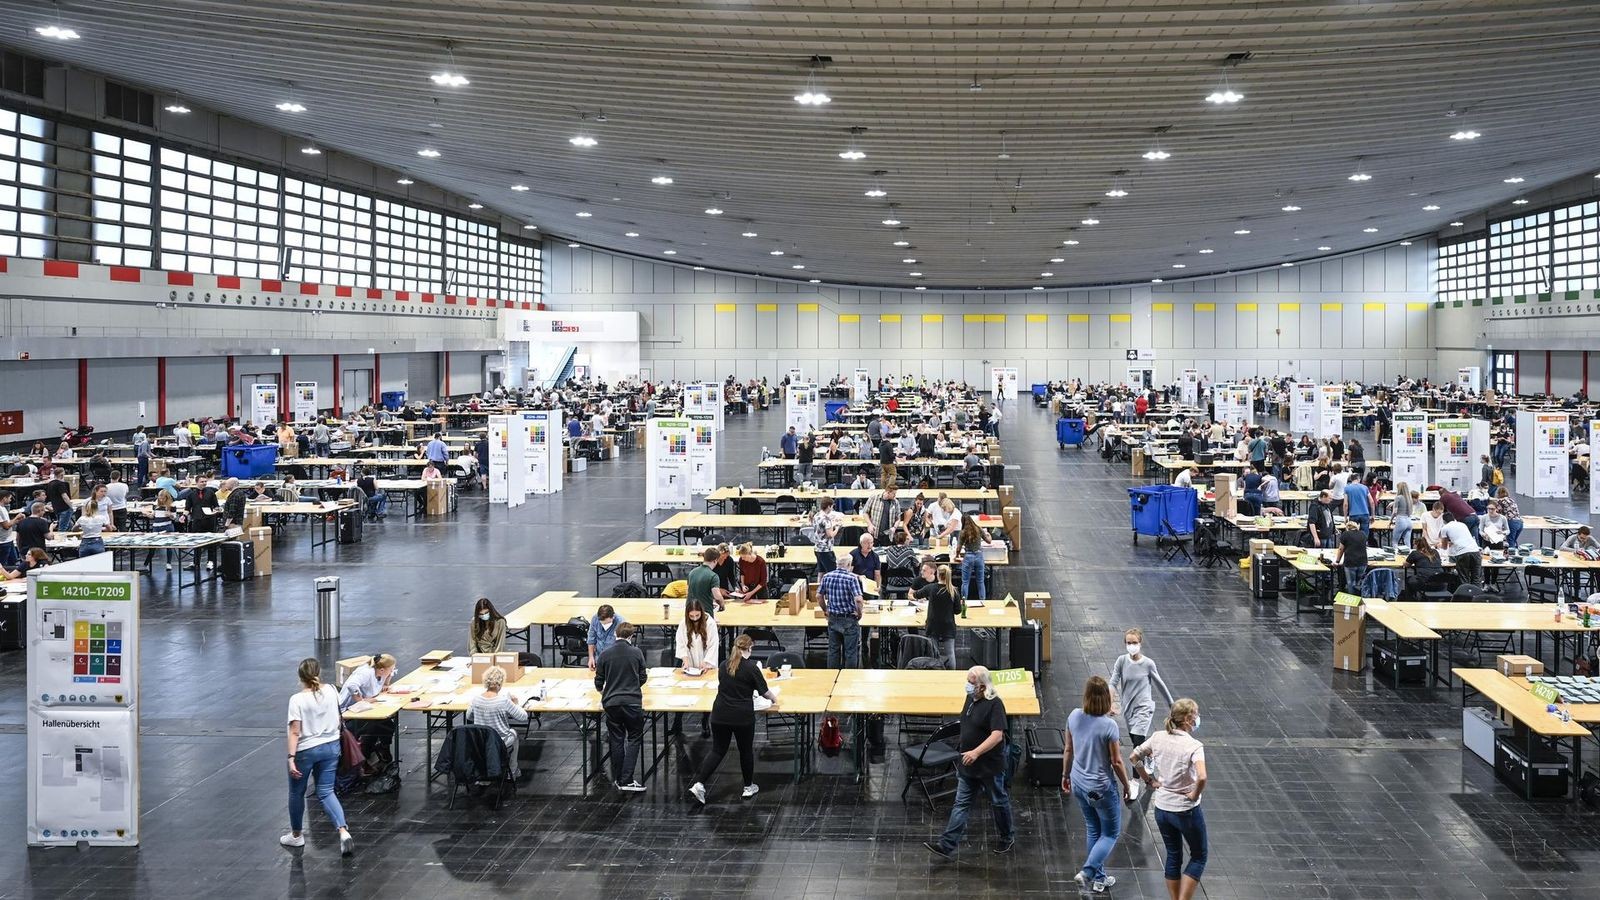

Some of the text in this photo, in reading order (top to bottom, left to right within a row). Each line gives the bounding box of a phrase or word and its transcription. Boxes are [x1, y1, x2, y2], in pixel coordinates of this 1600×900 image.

[42, 586, 48, 596] E
[996, 670, 1022, 682] 17205
[1535, 684, 1554, 700] 14210
[42, 720, 100, 728] Hallenübersicht
